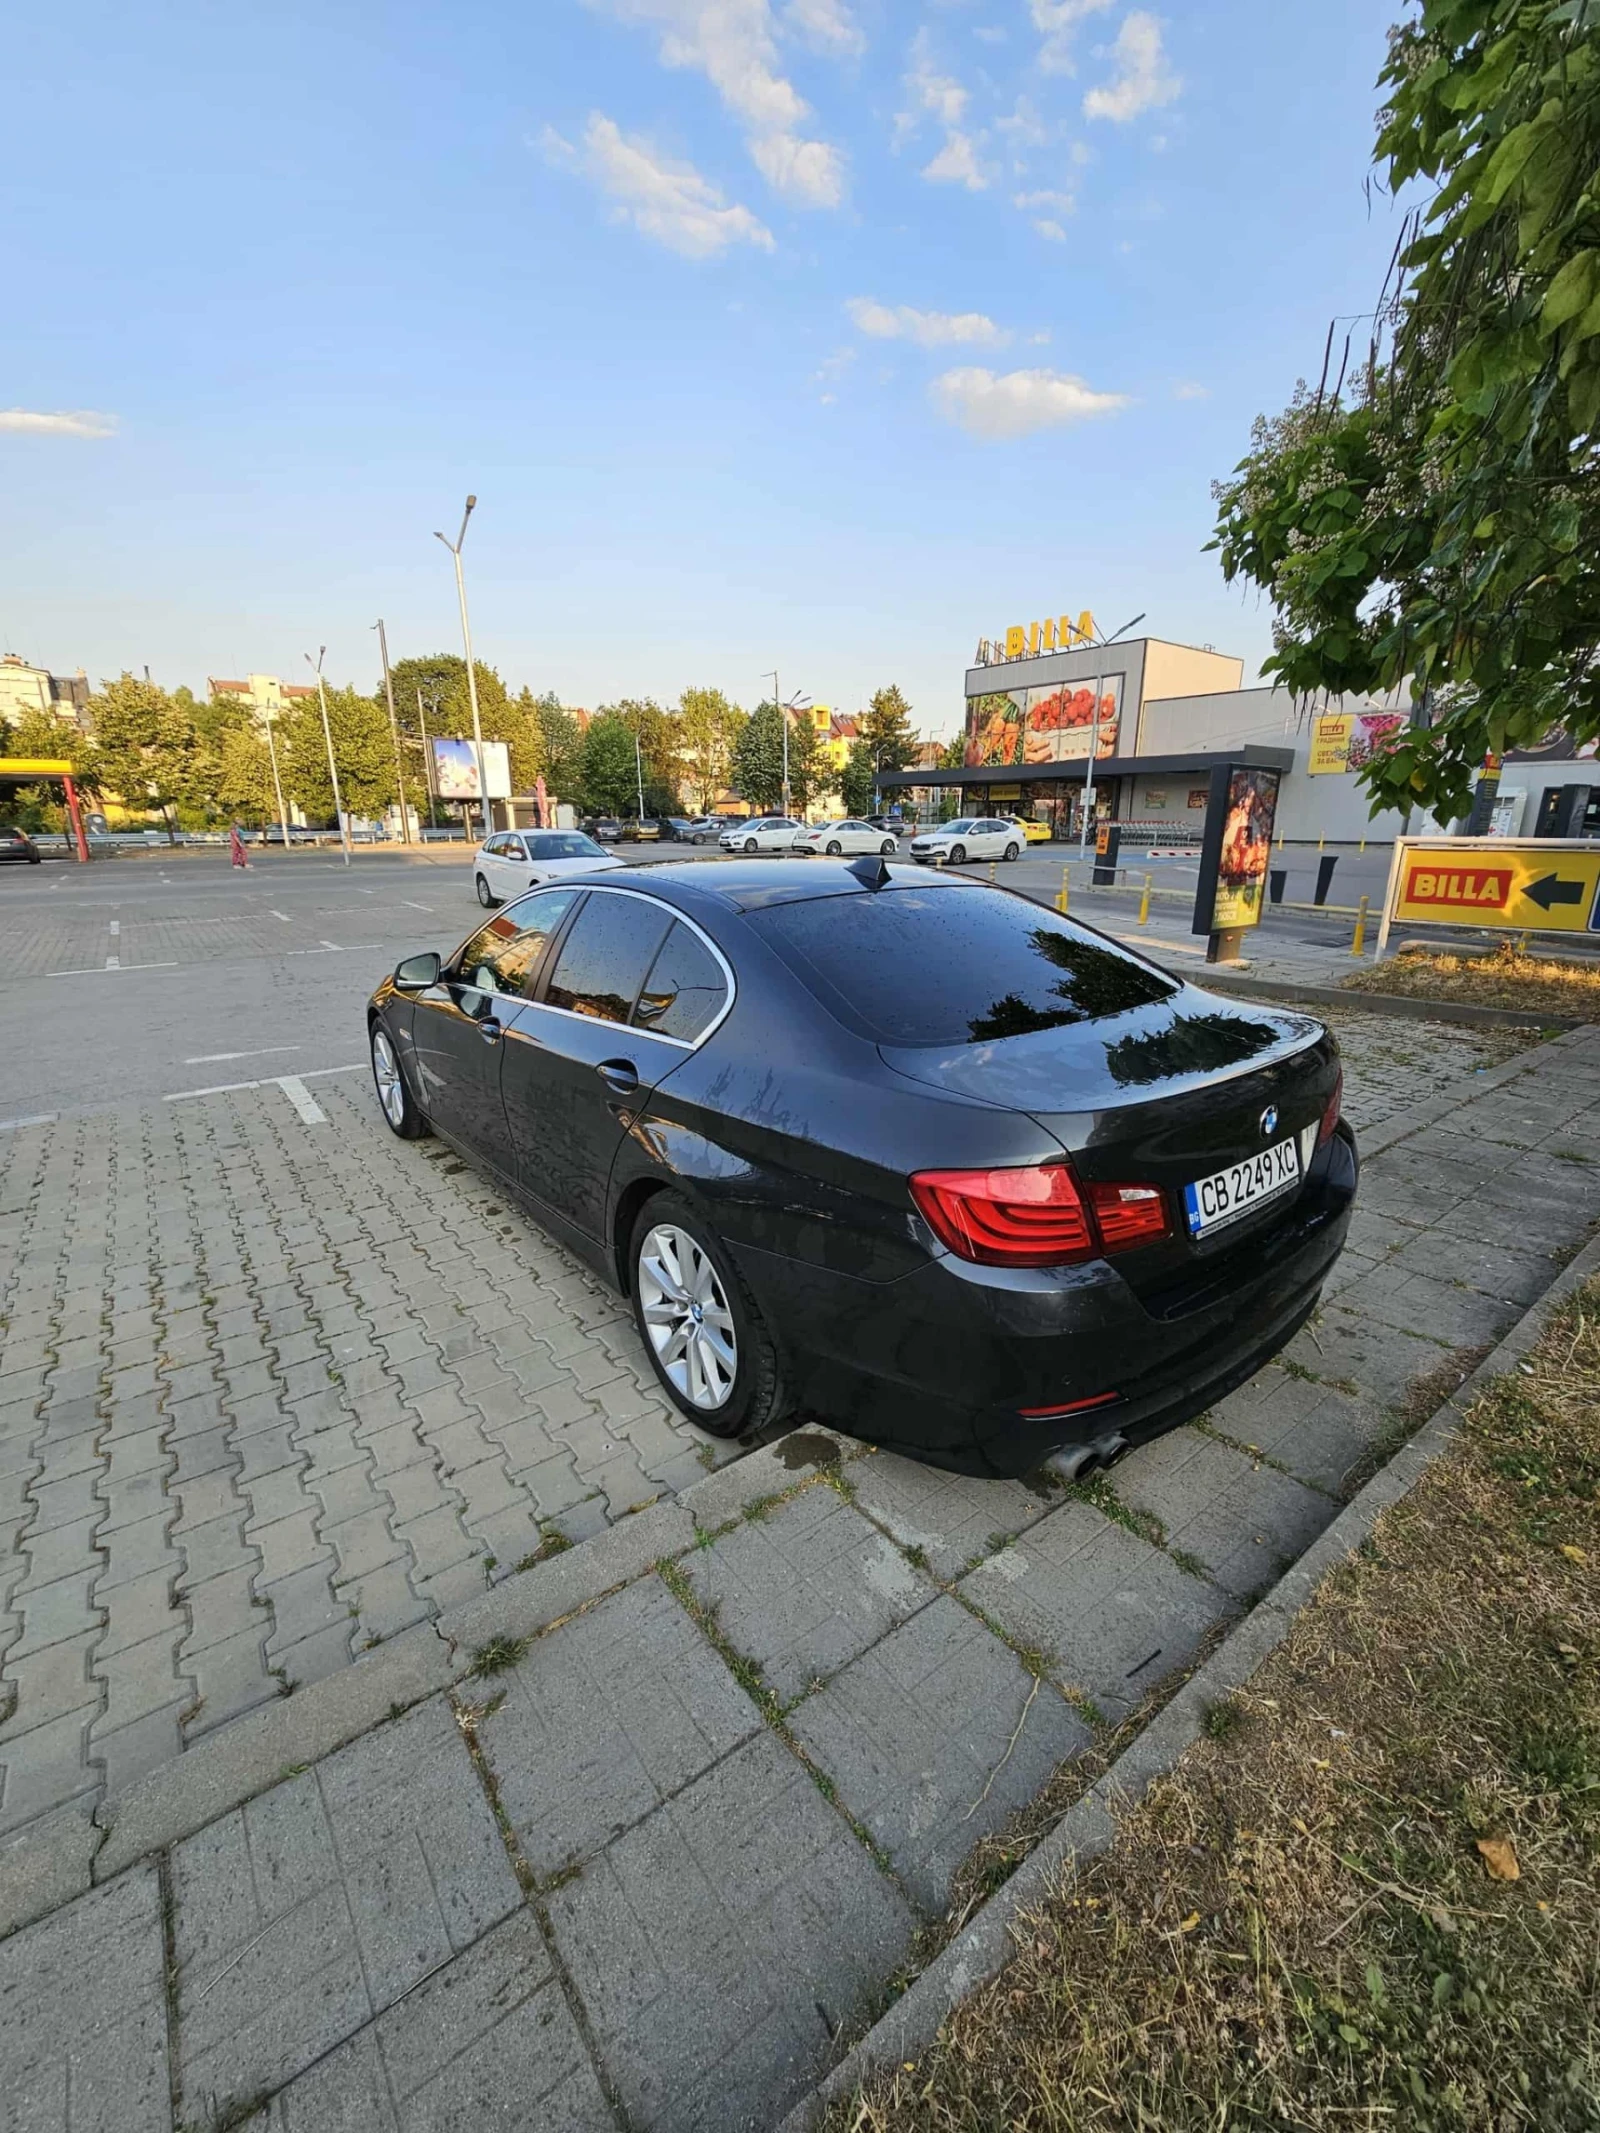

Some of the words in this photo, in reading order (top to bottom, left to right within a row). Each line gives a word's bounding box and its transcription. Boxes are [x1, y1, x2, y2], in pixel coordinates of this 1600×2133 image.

[1005, 610, 1094, 657] BILLA
[1321, 726, 1343, 734] BILLA
[1413, 873, 1501, 901] BILLA
[1201, 1175, 1229, 1217] CB
[1231, 1152, 1273, 1204] 2249
[1274, 1141, 1295, 1181] XC
[1188, 1211, 1200, 1225] BG
